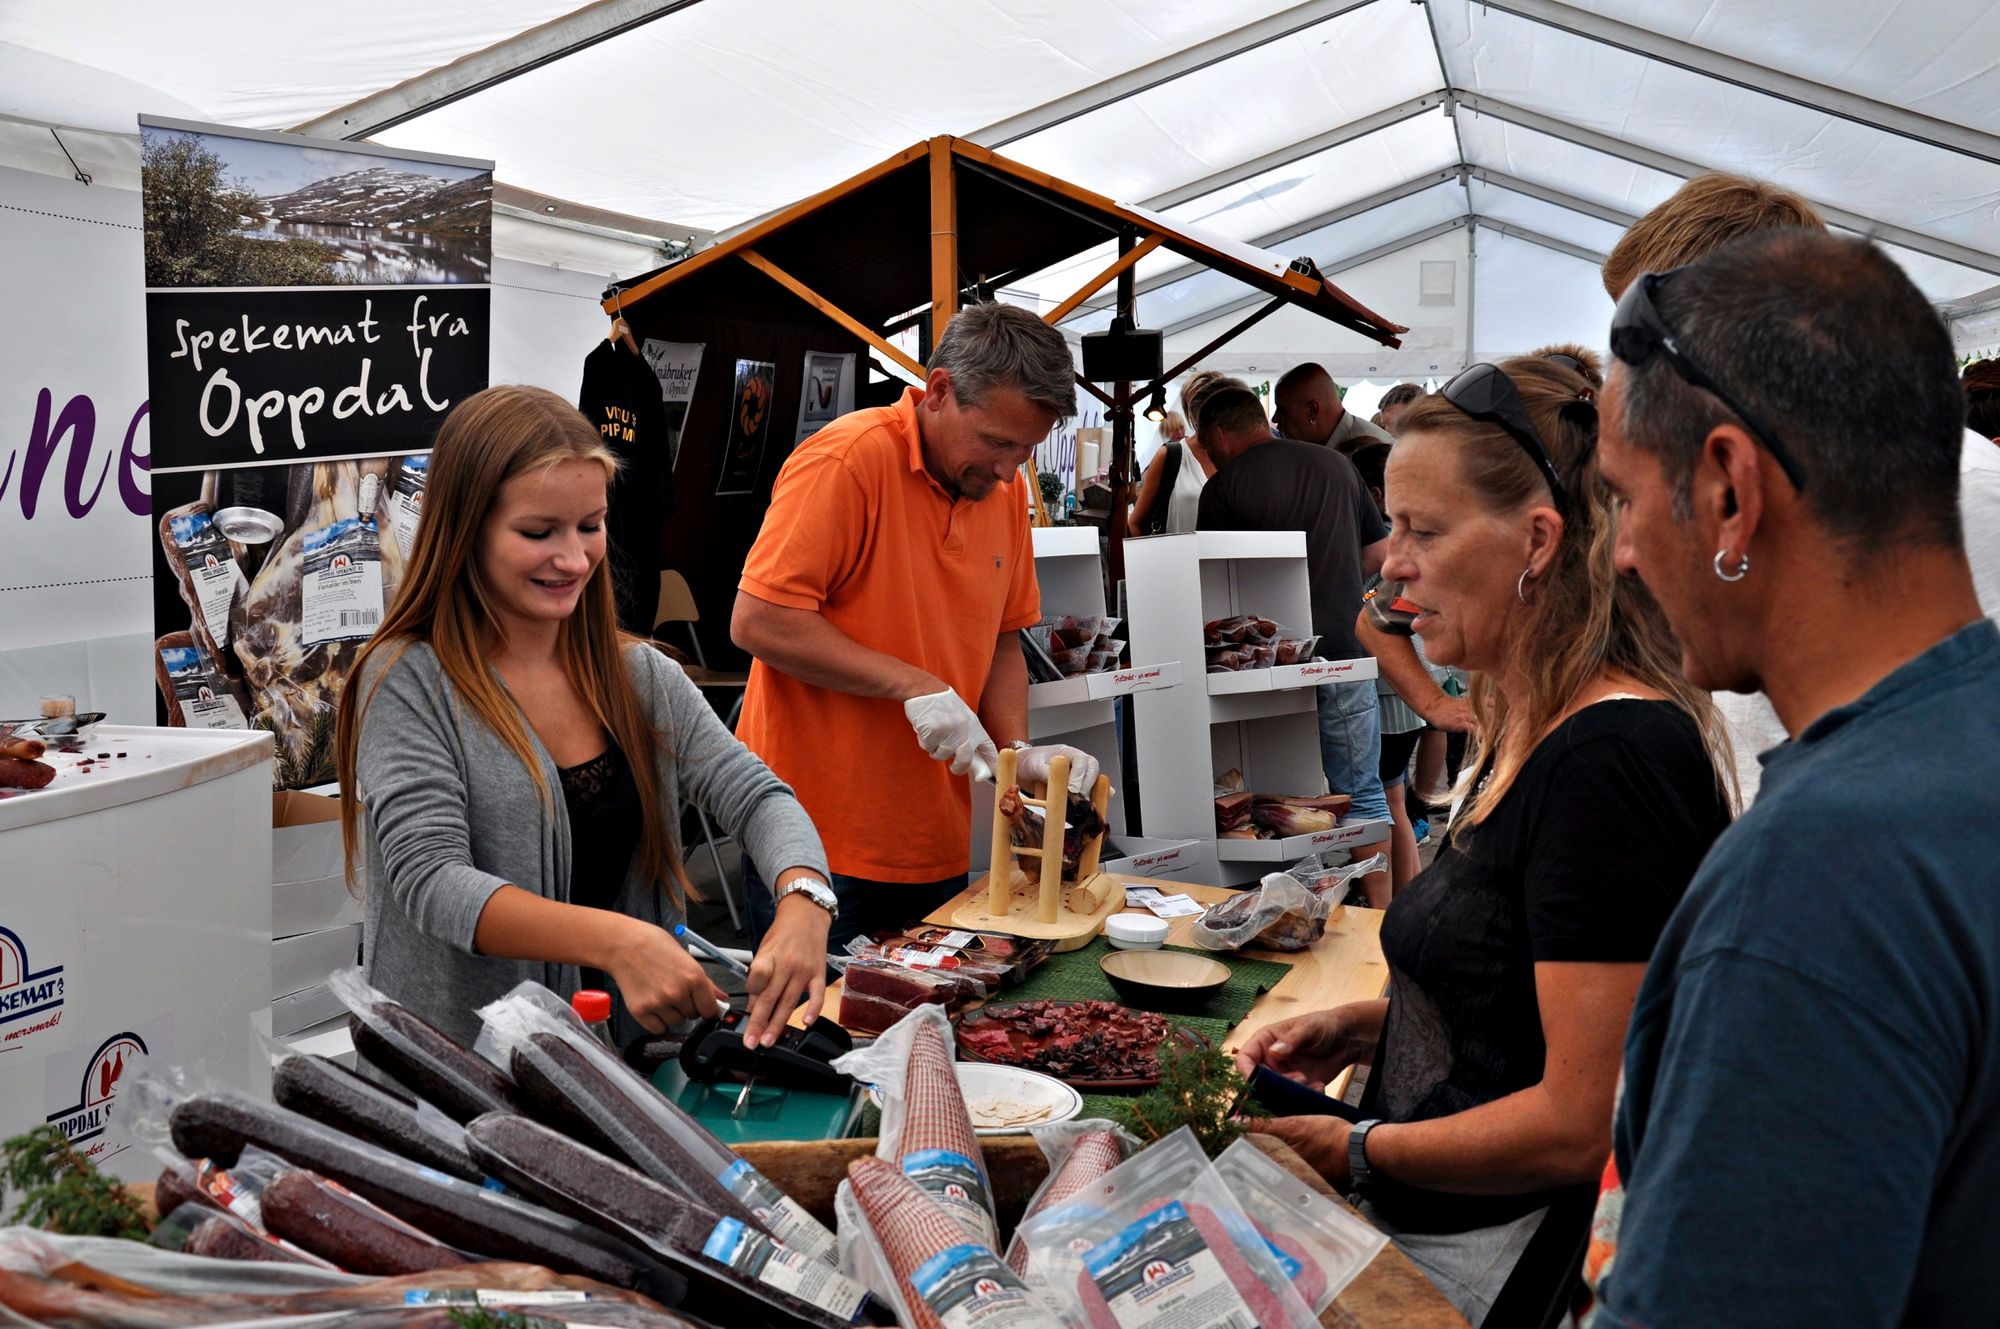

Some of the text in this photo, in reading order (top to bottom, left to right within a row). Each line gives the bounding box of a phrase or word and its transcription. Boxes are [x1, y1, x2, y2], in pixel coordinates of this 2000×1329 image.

[170, 295, 469, 371] Spekemat fra
[0, 387, 152, 520] ne
[200, 348, 449, 454] Oppdal
